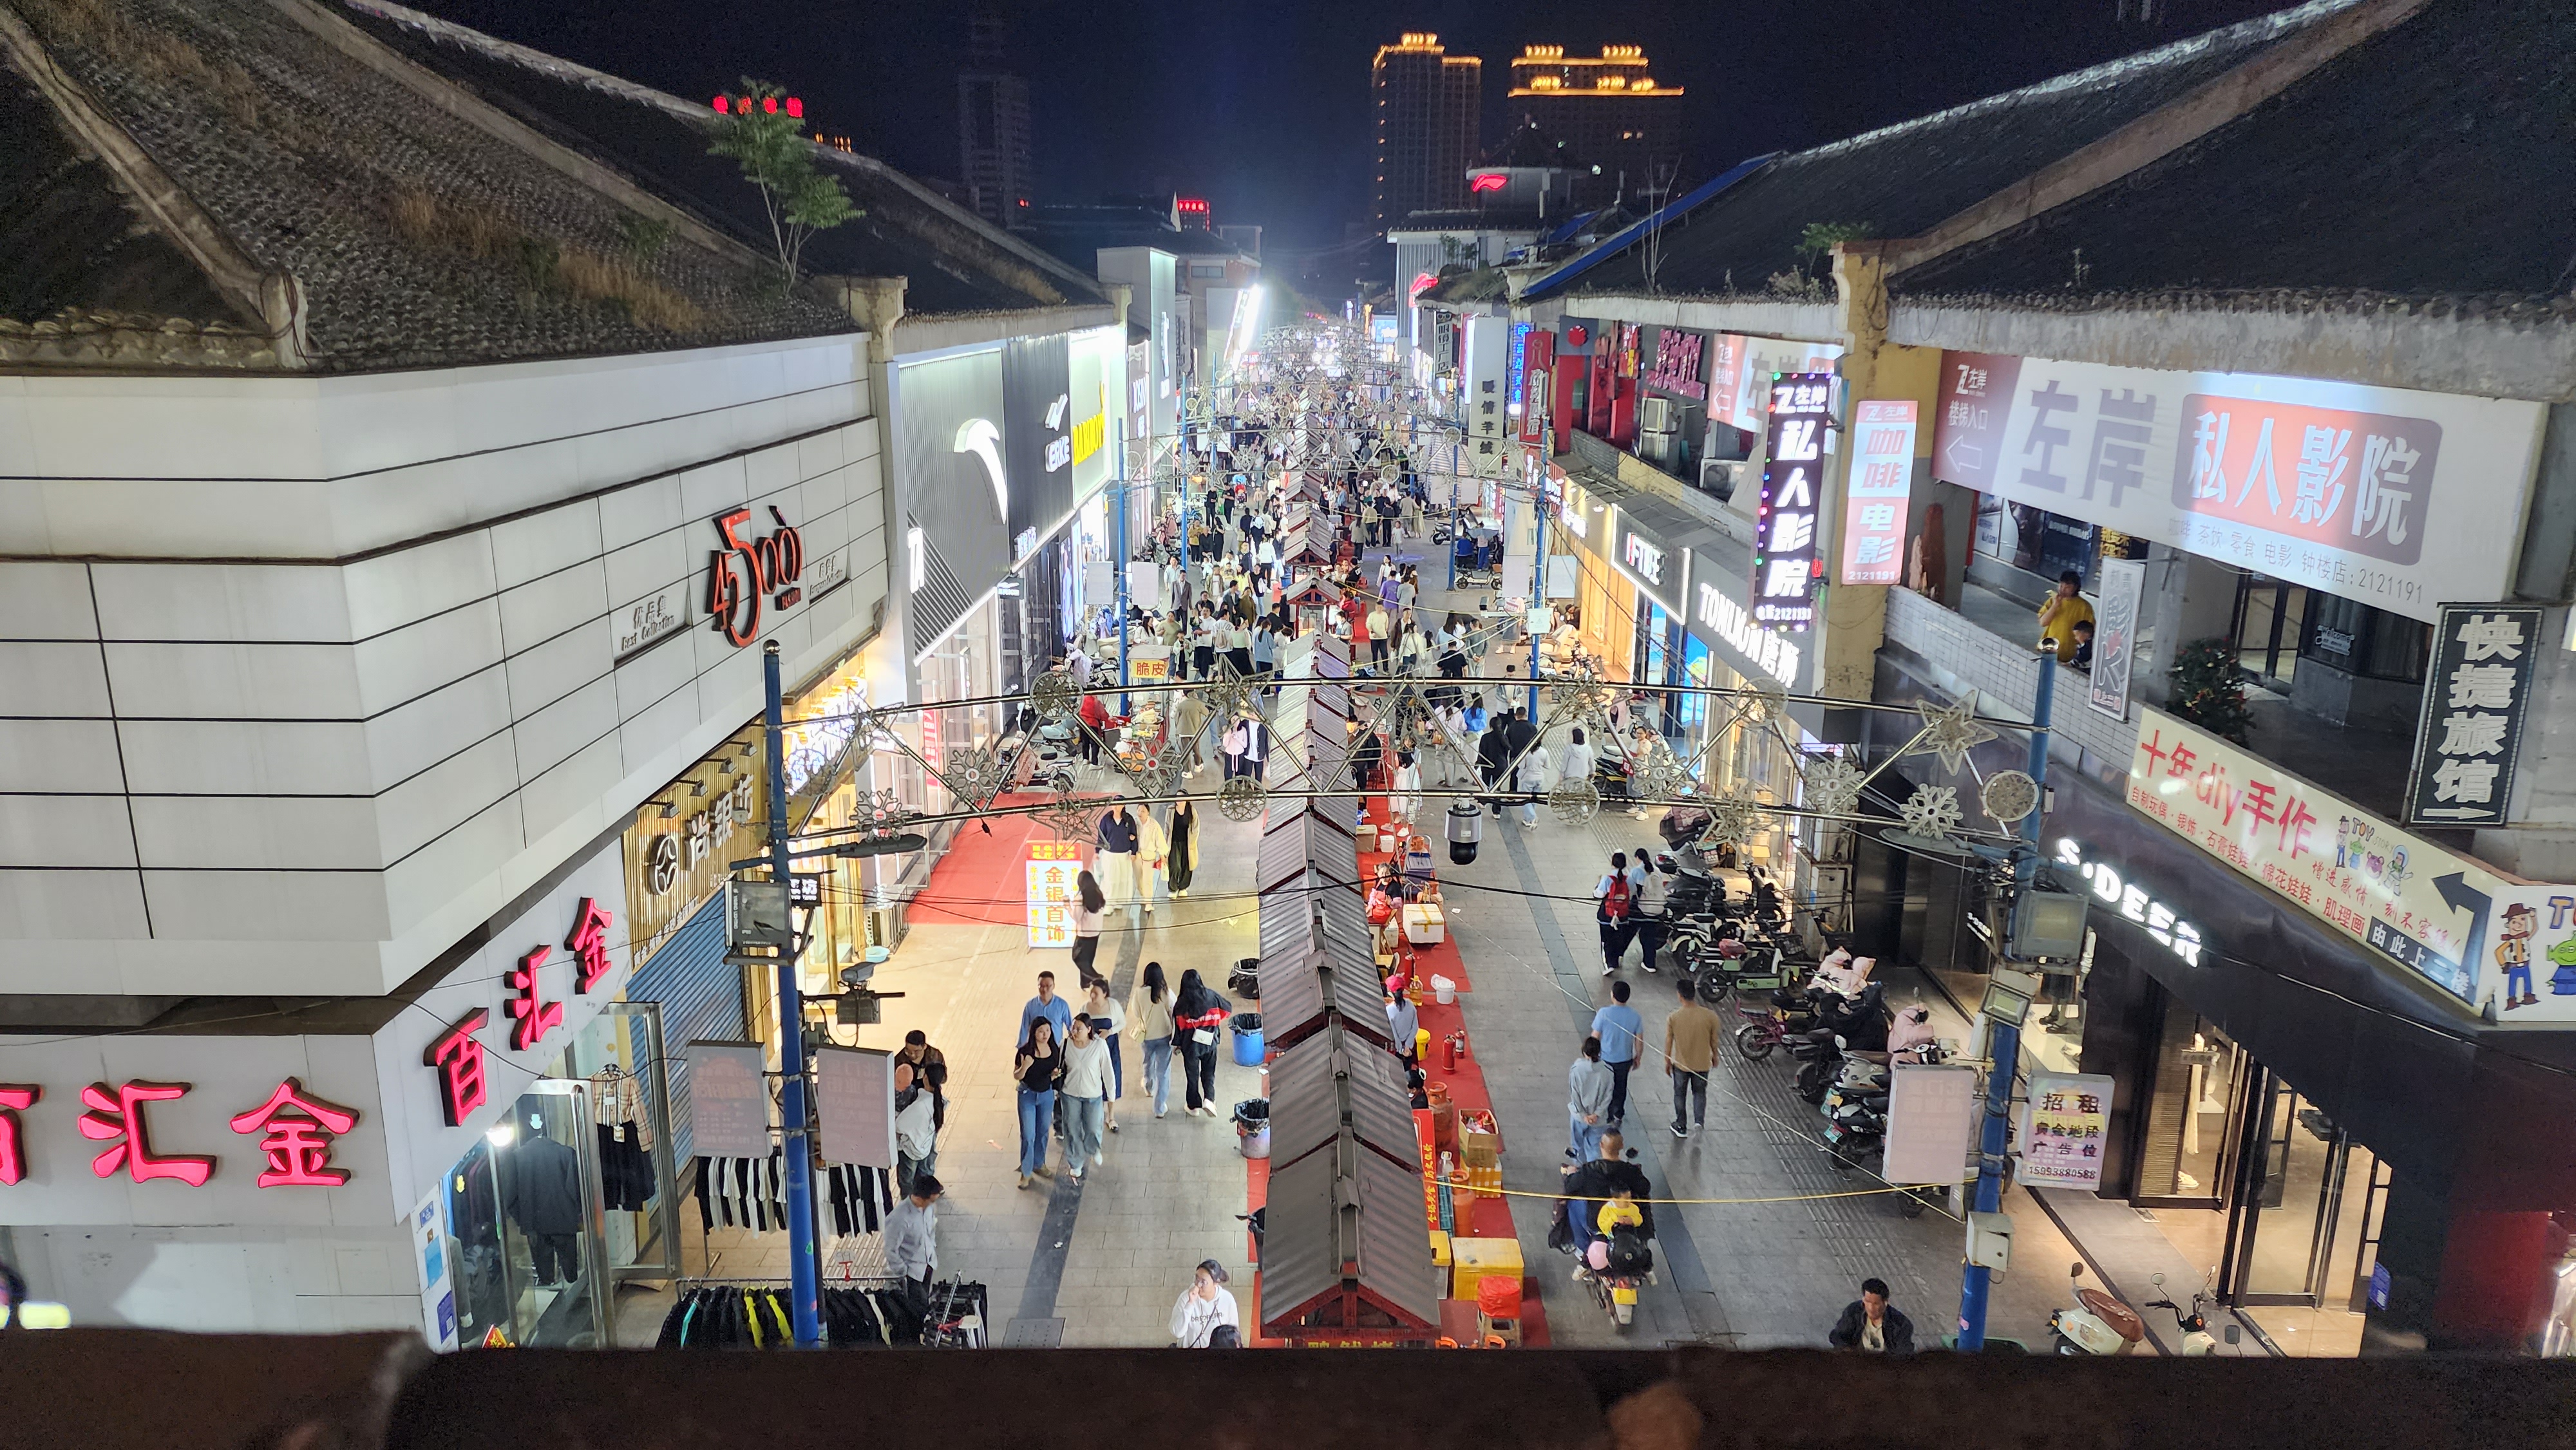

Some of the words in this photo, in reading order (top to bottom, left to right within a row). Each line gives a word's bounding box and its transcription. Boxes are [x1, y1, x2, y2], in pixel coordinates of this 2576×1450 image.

[1437, 324, 1450, 372] 眼镜工厂店
[1795, 385, 1827, 406] 左岸
[1968, 367, 1988, 390] 左岸
[1884, 405, 1908, 417] 左岸
[1948, 400, 1989, 431] 楼梯入口
[1046, 436, 1070, 472] ERKE
[1861, 428, 1907, 489] 咖啡
[2017, 379, 2157, 509] 左岸
[2188, 410, 2421, 546] 私人影院
[1763, 420, 1817, 597] 私人影院
[1853, 503, 1897, 565] 电影
[2198, 523, 2222, 549] 茶饮
[2230, 531, 2257, 559] 零食
[2264, 540, 2293, 568] 电影
[1848, 570, 1896, 581] 2121191
[1136, 662, 1165, 677] 脆皮
[2432, 614, 2525, 804] 快捷旅馆
[2141, 729, 2318, 860] 十年diy手作
[2352, 816, 2375, 842] TOY
[1045, 866, 1065, 942] 金银首饰
[2323, 896, 2366, 937] 肌理画
[2371, 923, 2470, 998] 由此上二楼
[423, 896, 613, 1127] 百汇金
[2041, 1092, 2101, 1114] 招租
[2032, 1141, 2097, 1158] 广告位
[2034, 1122, 2100, 1139] 黄金地段
